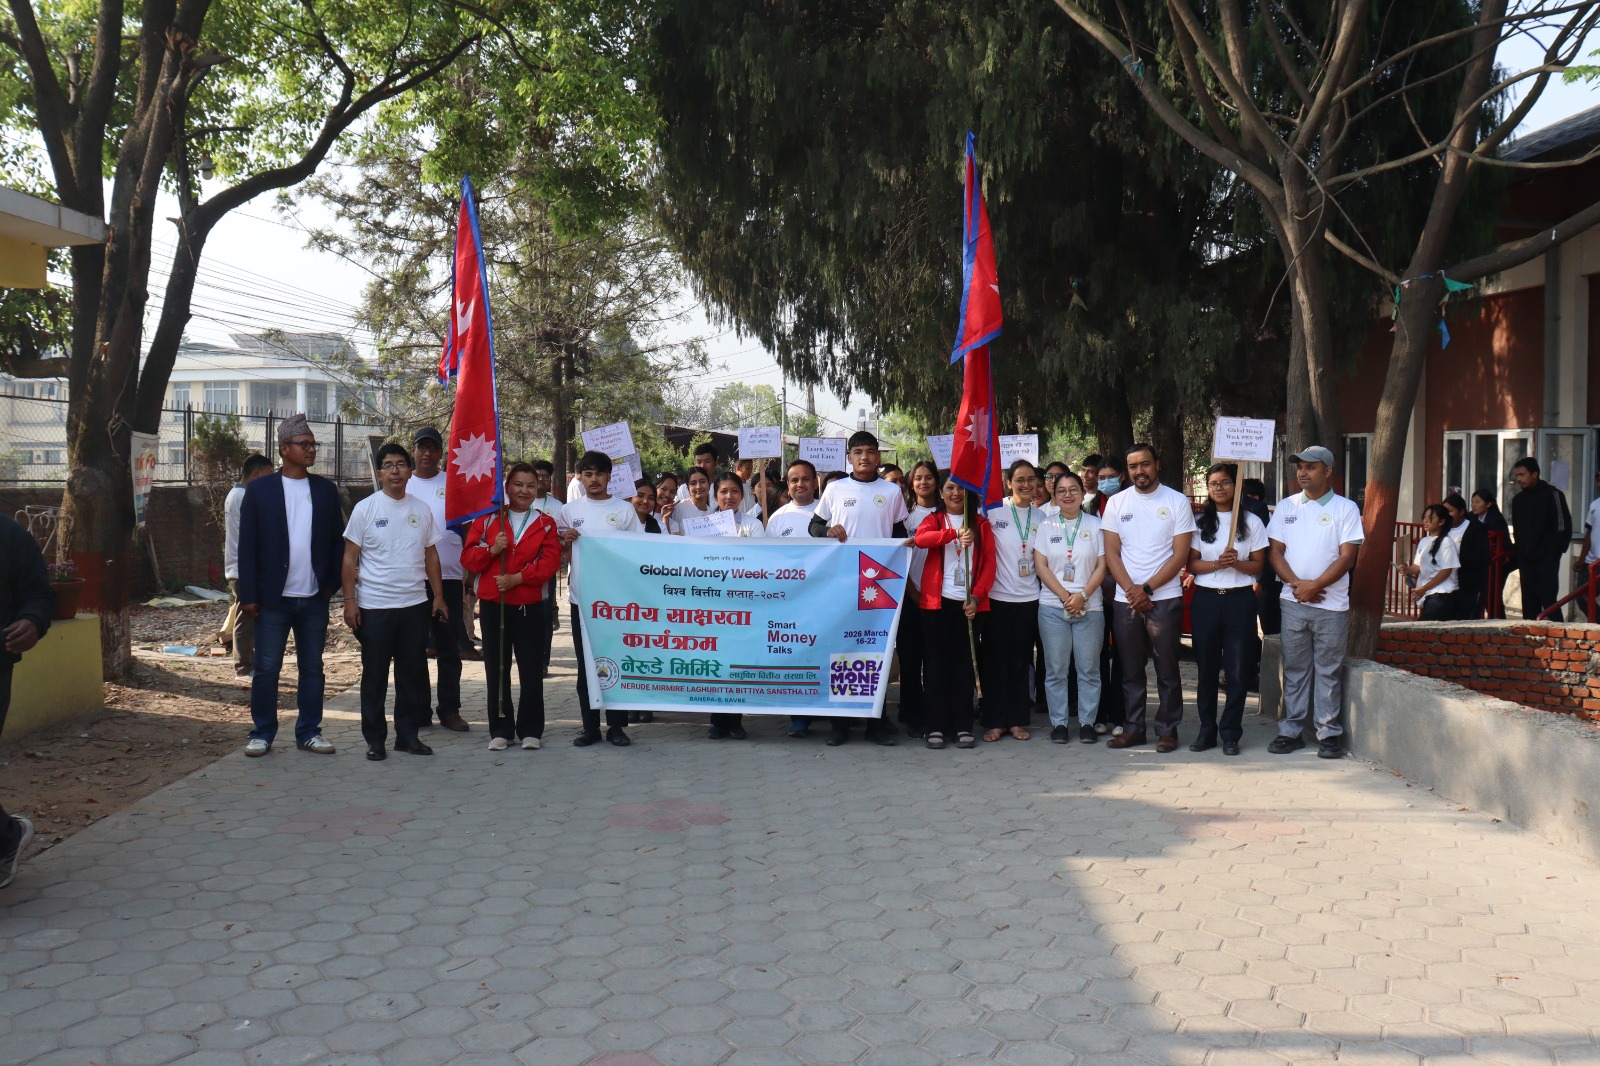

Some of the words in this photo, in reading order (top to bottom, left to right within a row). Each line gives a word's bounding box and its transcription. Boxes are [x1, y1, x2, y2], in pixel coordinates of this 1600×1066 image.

[640, 565, 682, 576] Global
[684, 567, 729, 581] Money
[731, 569, 806, 580] Week-2026
[663, 584, 686, 597] विश्व
[691, 586, 721, 598] वित्तीय
[591, 601, 659, 622] वित्तीय
[666, 609, 752, 626] साक्षरता
[768, 621, 796, 629] Smart
[623, 630, 718, 651] कार्यक्रम
[768, 630, 817, 646] Money
[767, 646, 792, 654] Talks
[670, 658, 723, 677] मिर्मिरे
[652, 684, 684, 692] MIRMIRE
[686, 685, 734, 693] LAGHUBITTA
